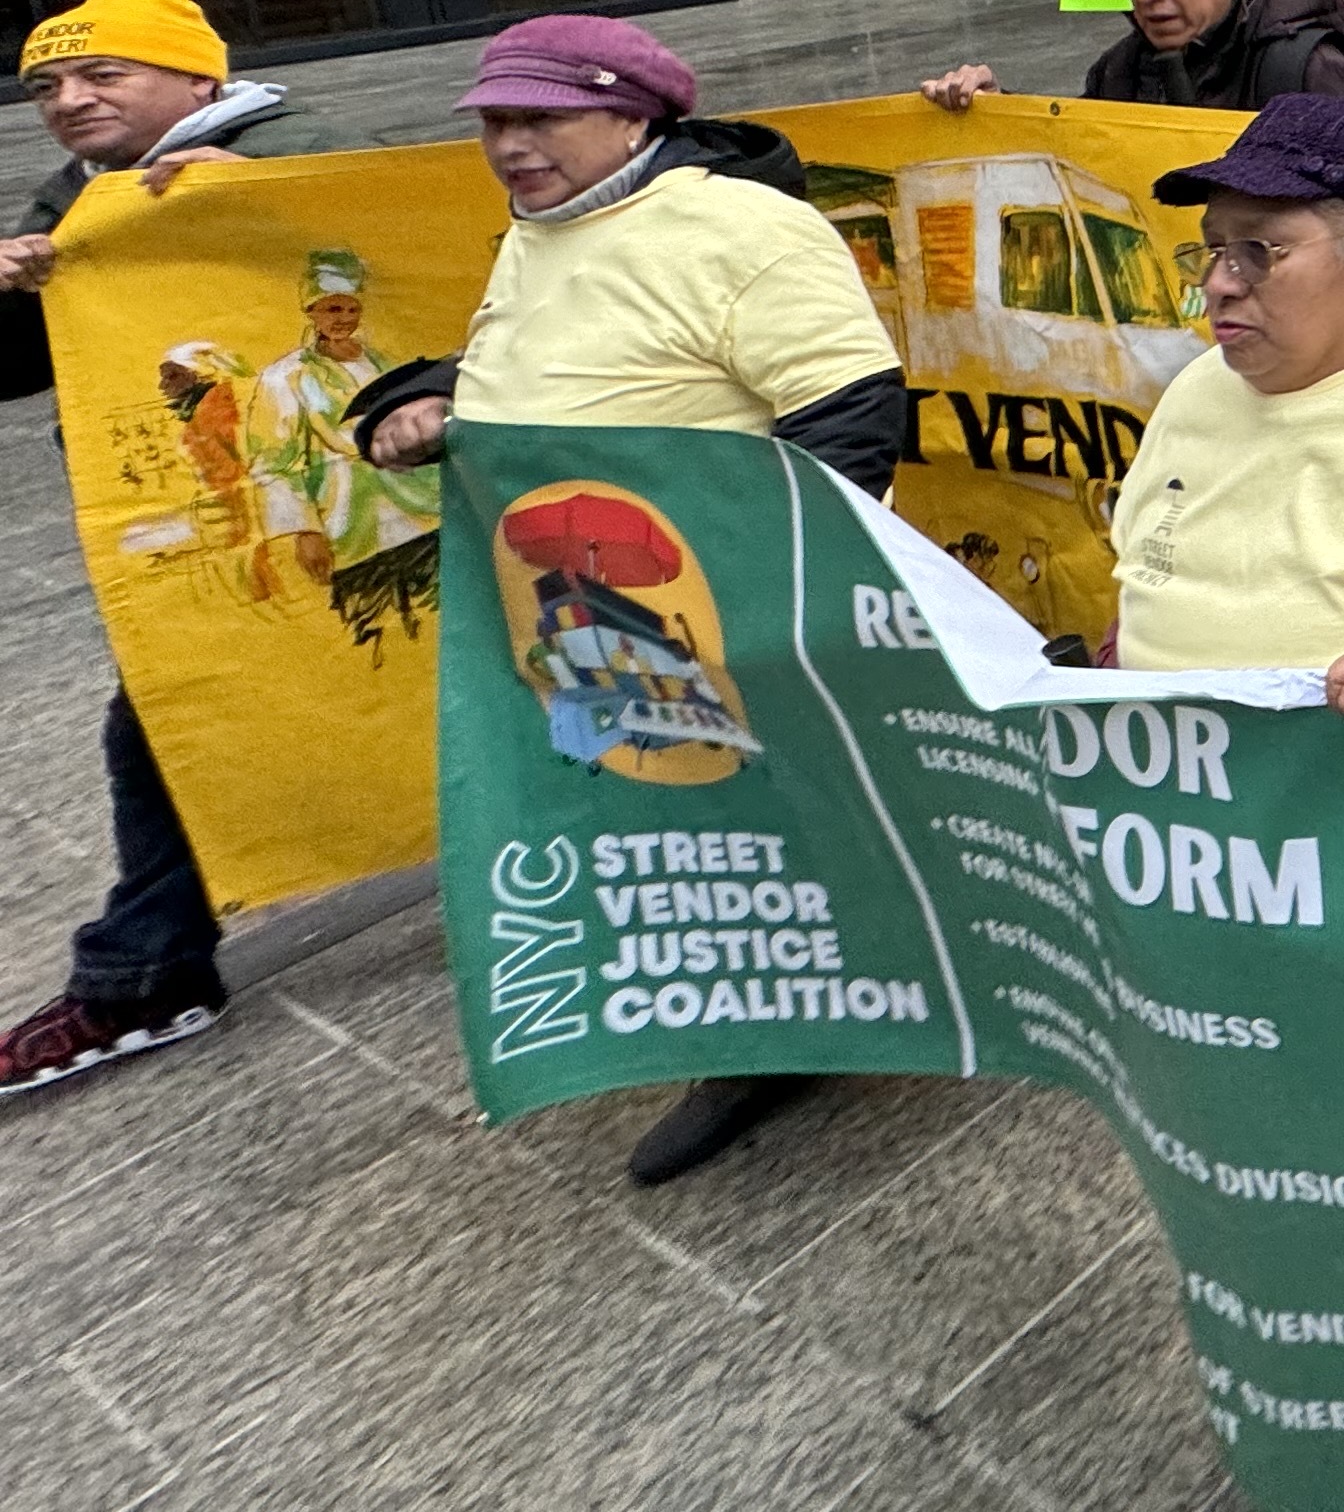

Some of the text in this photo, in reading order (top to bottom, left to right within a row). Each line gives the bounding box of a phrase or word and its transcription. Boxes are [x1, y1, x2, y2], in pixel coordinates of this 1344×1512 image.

[1045, 701, 1232, 801] DOR
[593, 831, 788, 878] STREET
[1060, 804, 1324, 927] FORM
[595, 881, 833, 927] VENDOR
[490, 833, 589, 1064] NYC
[600, 928, 843, 981] JUSTICE
[601, 977, 930, 1036] COALITION
